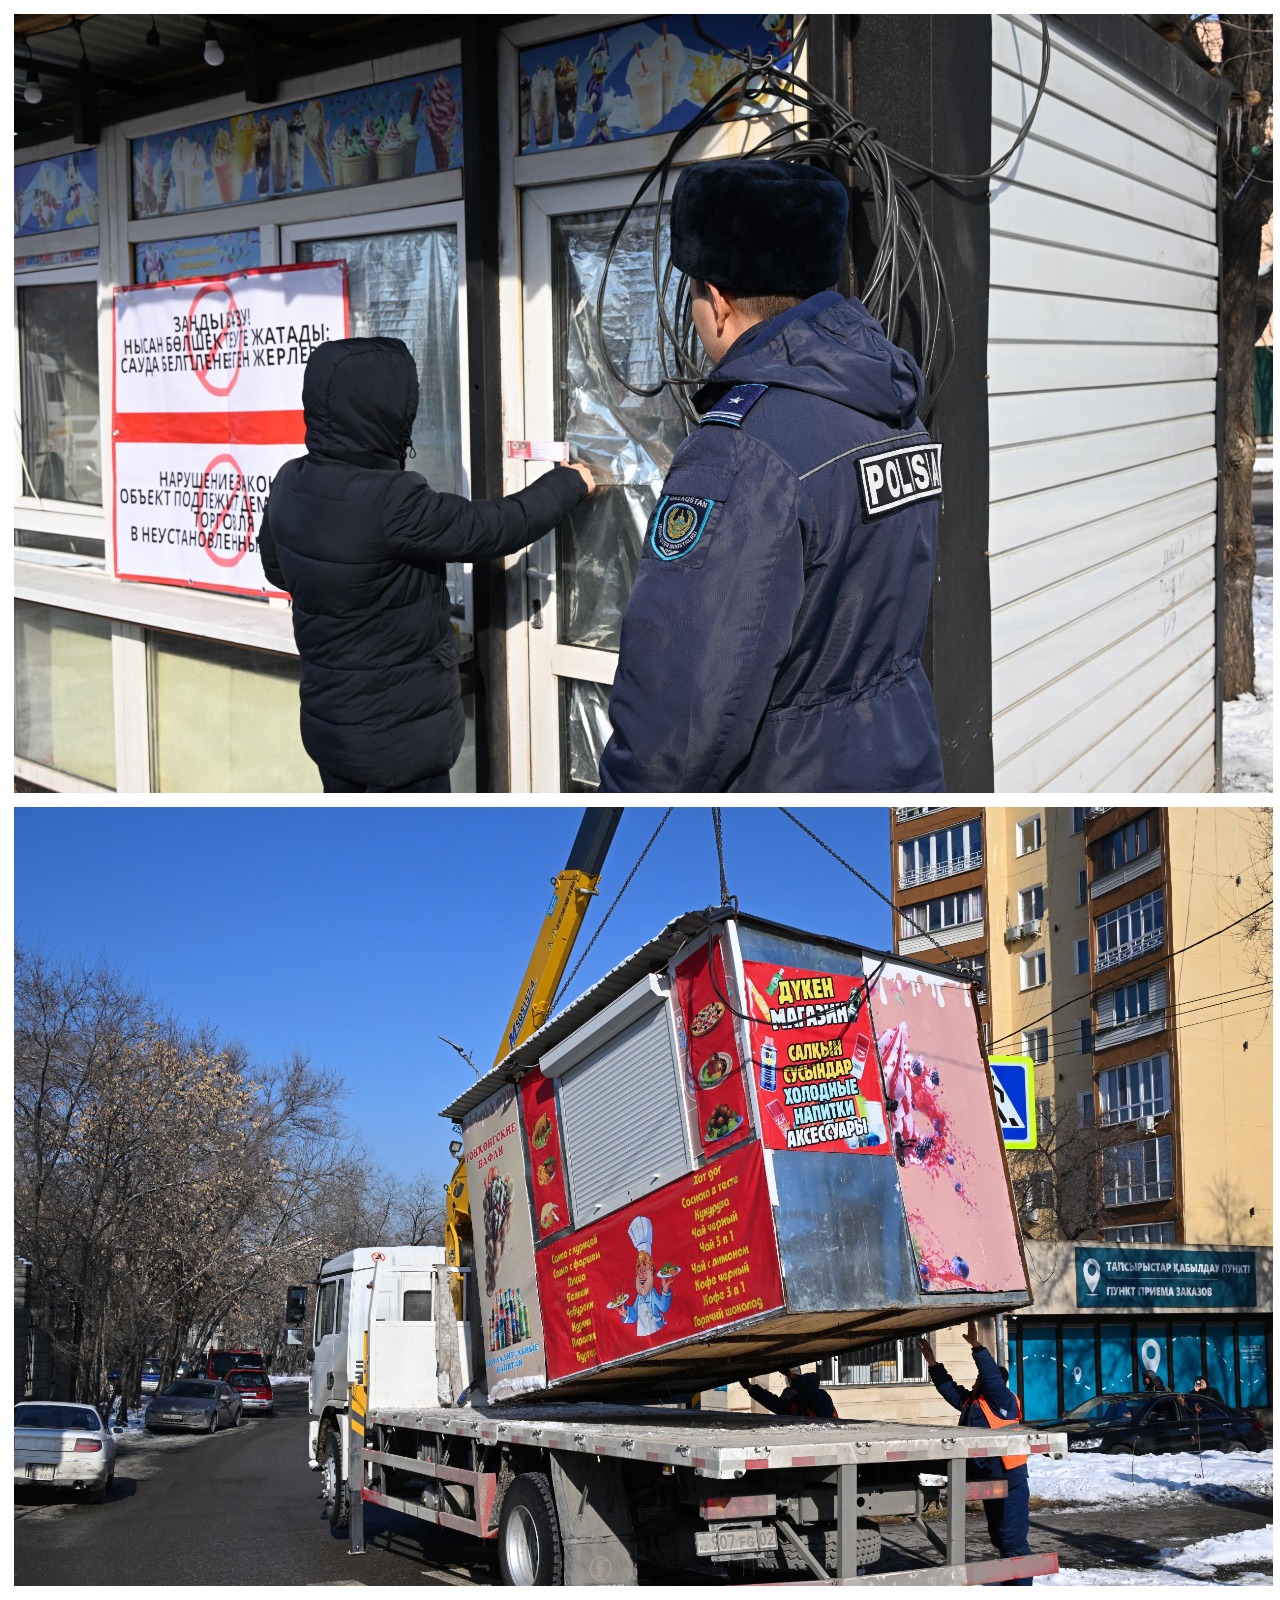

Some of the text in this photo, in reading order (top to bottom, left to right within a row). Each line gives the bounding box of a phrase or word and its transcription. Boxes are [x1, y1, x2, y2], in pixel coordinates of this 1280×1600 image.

[173, 313, 223, 336] ЗАҢДЫ
[124, 336, 163, 354] НЫСАН
[251, 323, 330, 347] ЖАТАДЫ:
[121, 356, 159, 377] САУДА
[159, 471, 234, 491] НАРУШЕНИЕ
[120, 488, 170, 506] ОБЪЕКТ
[174, 491, 238, 513] ПОДЛЕЖИТ
[131, 526, 138, 541] В
[193, 511, 254, 532] ТОРГОВЛЯ
[770, 1002, 849, 1031] МАГАЗИН
[787, 1039, 843, 1062] САЛҚЫН
[783, 1059, 853, 1083] СУСЫНДАР
[783, 1078, 859, 1105] ХОЛОДНЫЕ
[793, 1099, 856, 1125] НАПИТКИ
[787, 1117, 869, 1149] АКСЕССУАРЫ
[693, 1165, 721, 1186] Хот дог
[681, 1175, 739, 1208] Сосиска в тесте
[694, 1198, 730, 1221] Кукуруза
[691, 1210, 739, 1238] Чай черный
[699, 1230, 735, 1252] Чай 3 в 1
[691, 1260, 706, 1274] Чай
[711, 1245, 749, 1267] лимоном
[1106, 1261, 1171, 1272] ТАПСЫРЫСТАР
[1173, 1262, 1220, 1275] ҚАБЫЛДАУ
[695, 1261, 750, 1291] Кофе черный
[703, 1281, 746, 1307] Кофе 3 в 1
[1106, 1286, 1213, 1297] ПУНКТ ПРИЕМА ЗАКАЗОВ
[693, 1297, 763, 1328] Горячий шоколад
[739, 1536, 755, 1548] FG
[760, 1531, 774, 1546] 02
